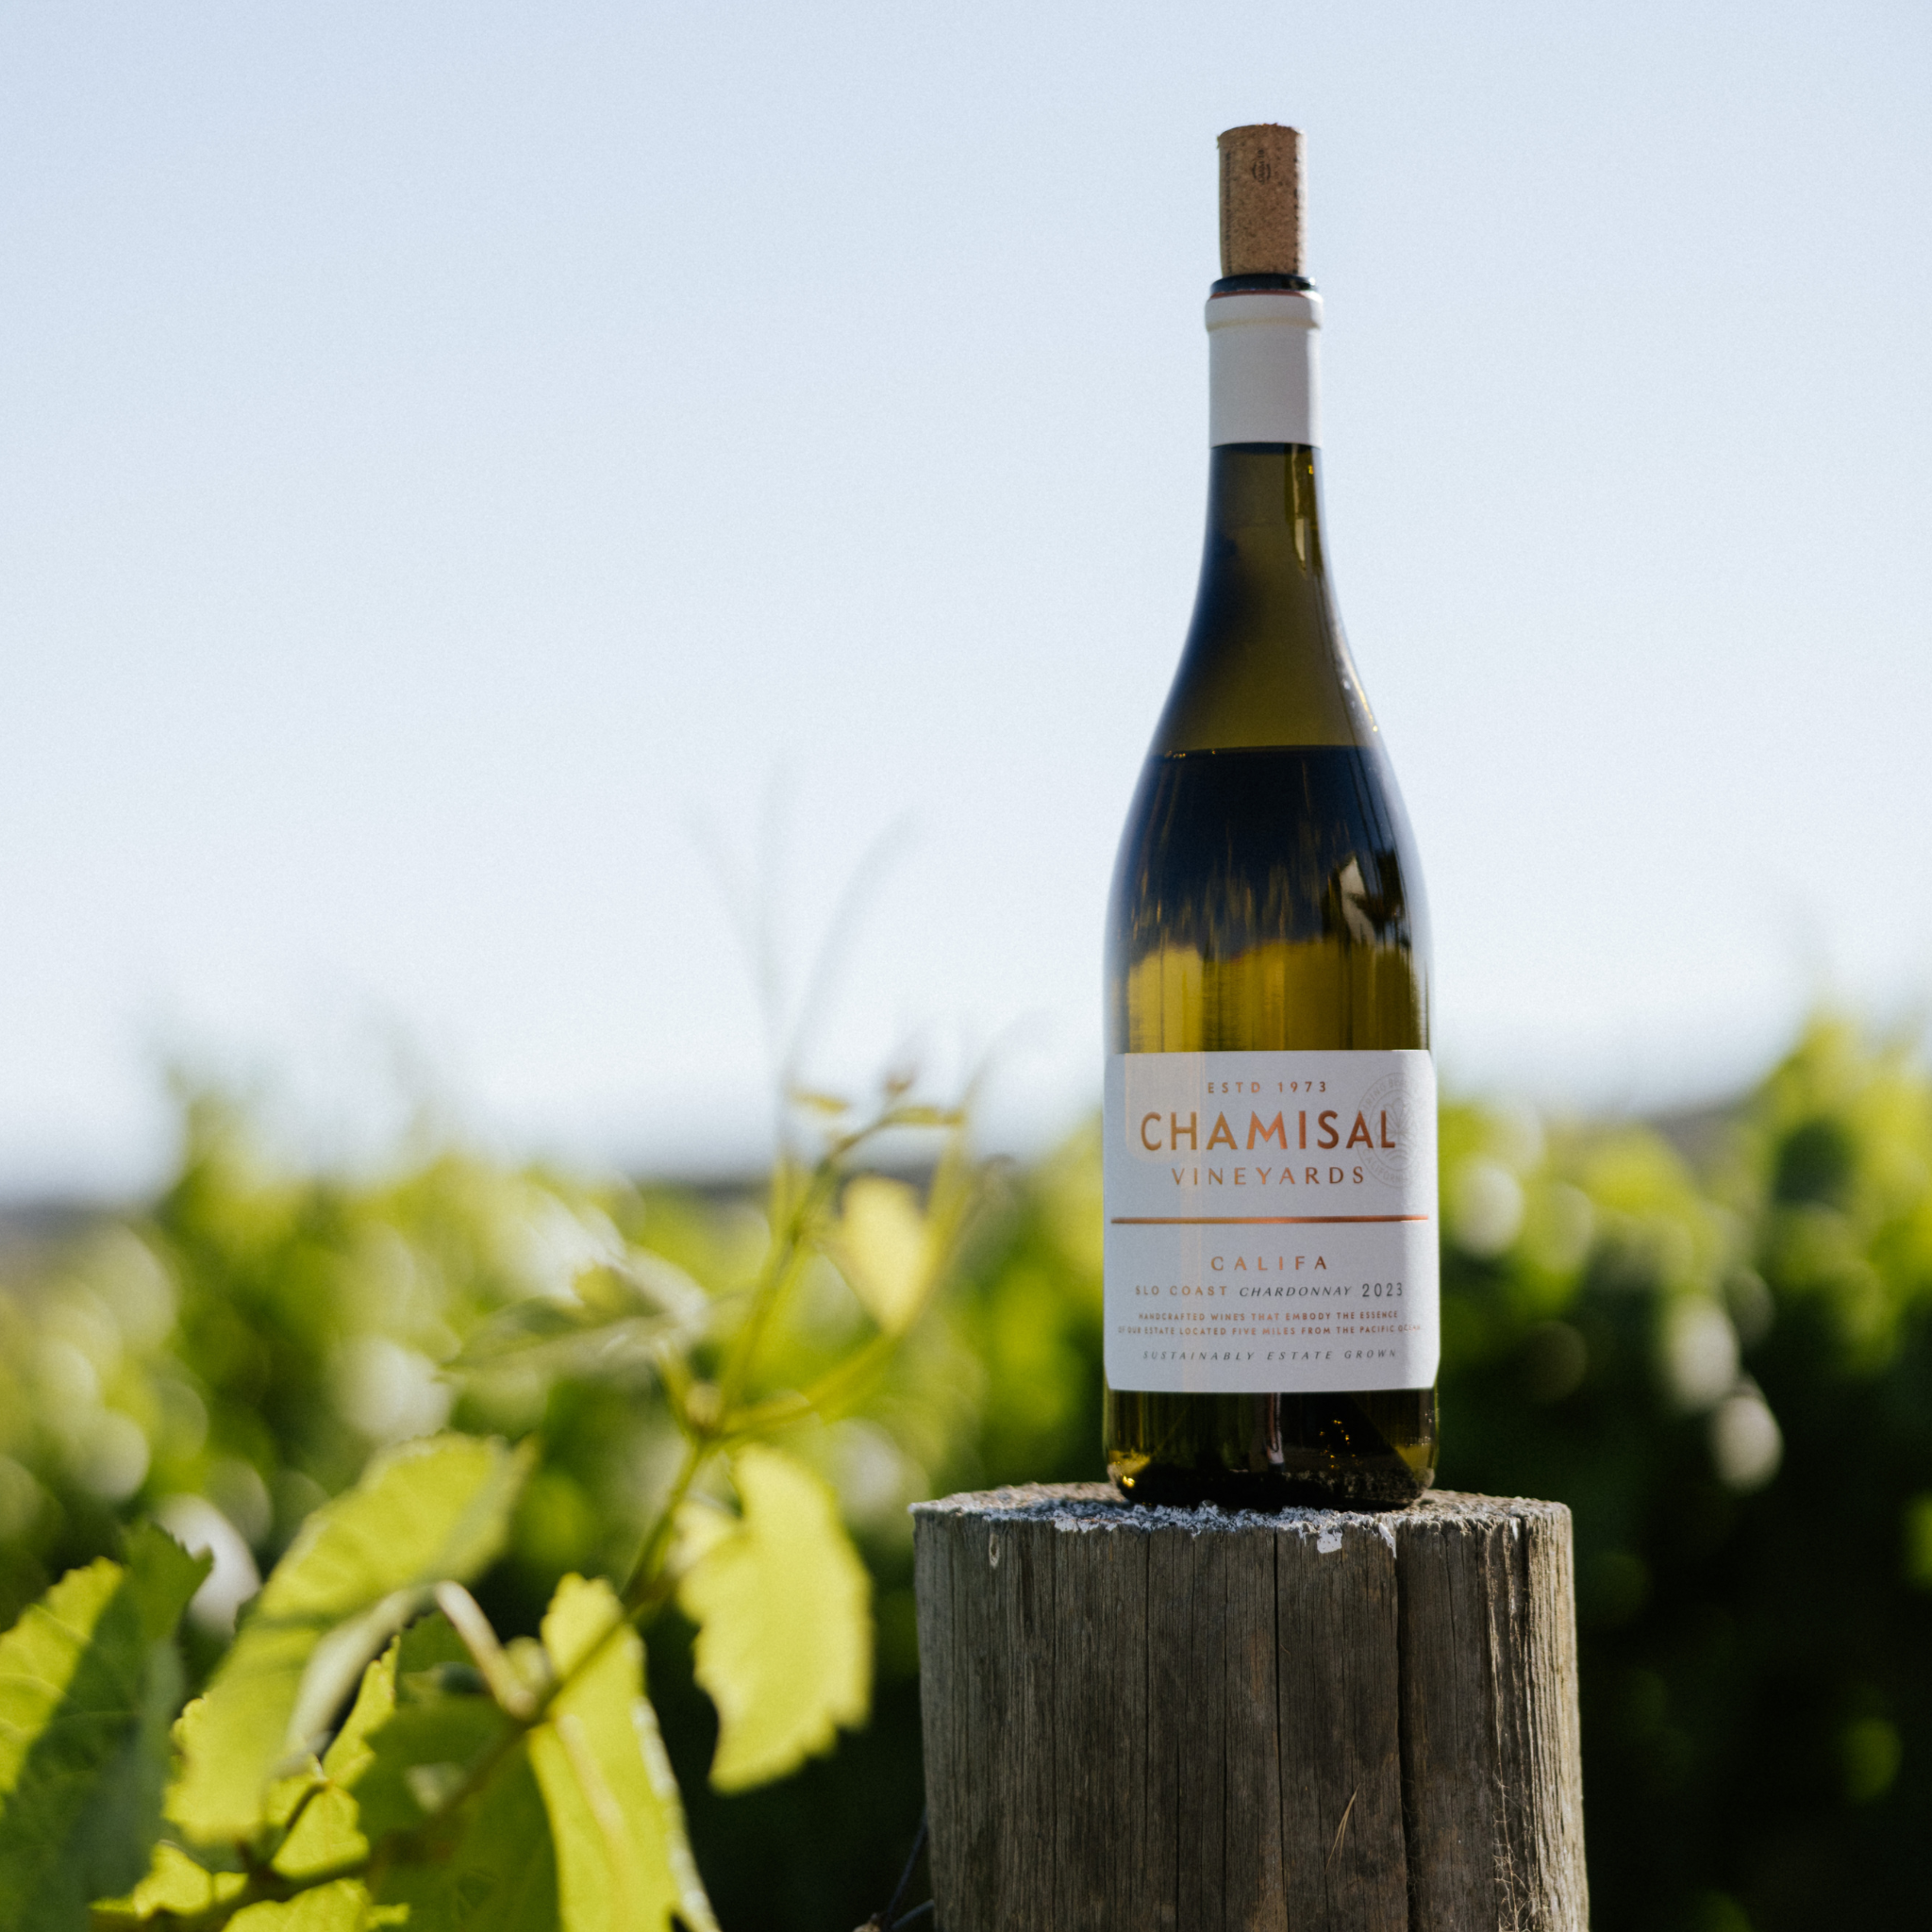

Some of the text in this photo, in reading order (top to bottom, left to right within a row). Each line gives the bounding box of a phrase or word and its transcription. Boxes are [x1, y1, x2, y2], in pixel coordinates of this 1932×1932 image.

[1208, 1081, 1325, 1093] ESTD 1973
[1141, 1110, 1395, 1151] CHAMISAL
[1173, 1166, 1363, 1185] VINEYARDS
[1210, 1256, 1326, 1271] CALIFA
[1135, 1282, 1402, 1298] SLO COAST CHARDONNAY 2023
[1139, 1310, 1398, 1322] HANDCRAFTED WINES THAT EMBODY THE ESSENCE
[1143, 1326, 1175, 1336] ESTATE
[1179, 1326, 1227, 1336] LOCATED
[1231, 1327, 1257, 1336] FIVE
[1261, 1326, 1296, 1336] MILES
[1301, 1326, 1331, 1335] FROM
[1336, 1325, 1355, 1335] THE
[1358, 1324, 1394, 1334] PACIFIC
[1142, 1349, 1396, 1361] SUSTAINABLY ESTATE GROWN
